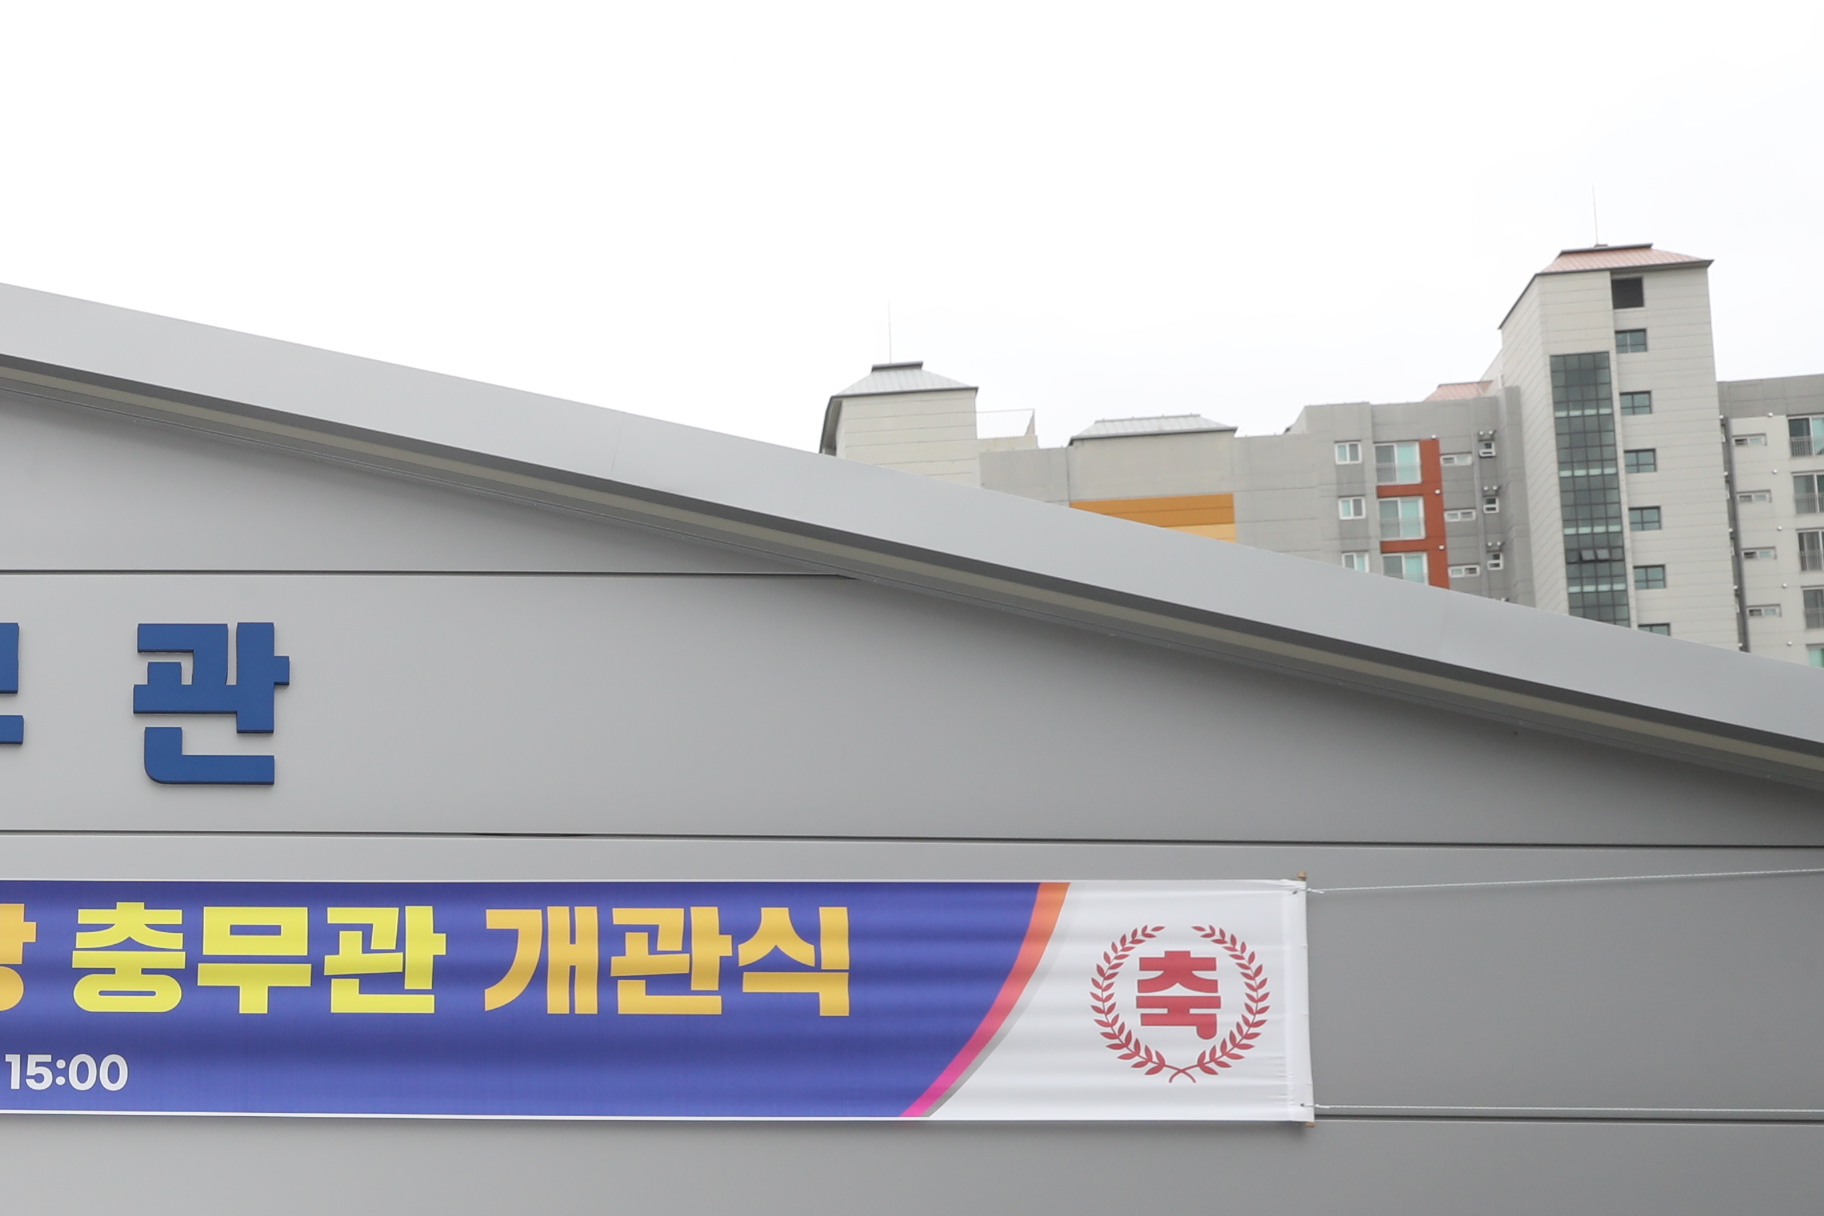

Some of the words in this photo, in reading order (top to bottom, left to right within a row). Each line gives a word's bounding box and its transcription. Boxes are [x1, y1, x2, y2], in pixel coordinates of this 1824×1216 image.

[72, 902, 446, 1014] 충무관
[484, 905, 851, 1017] 개관식
[1136, 950, 1222, 1039] 축
[5, 1053, 129, 1093] 15:00
